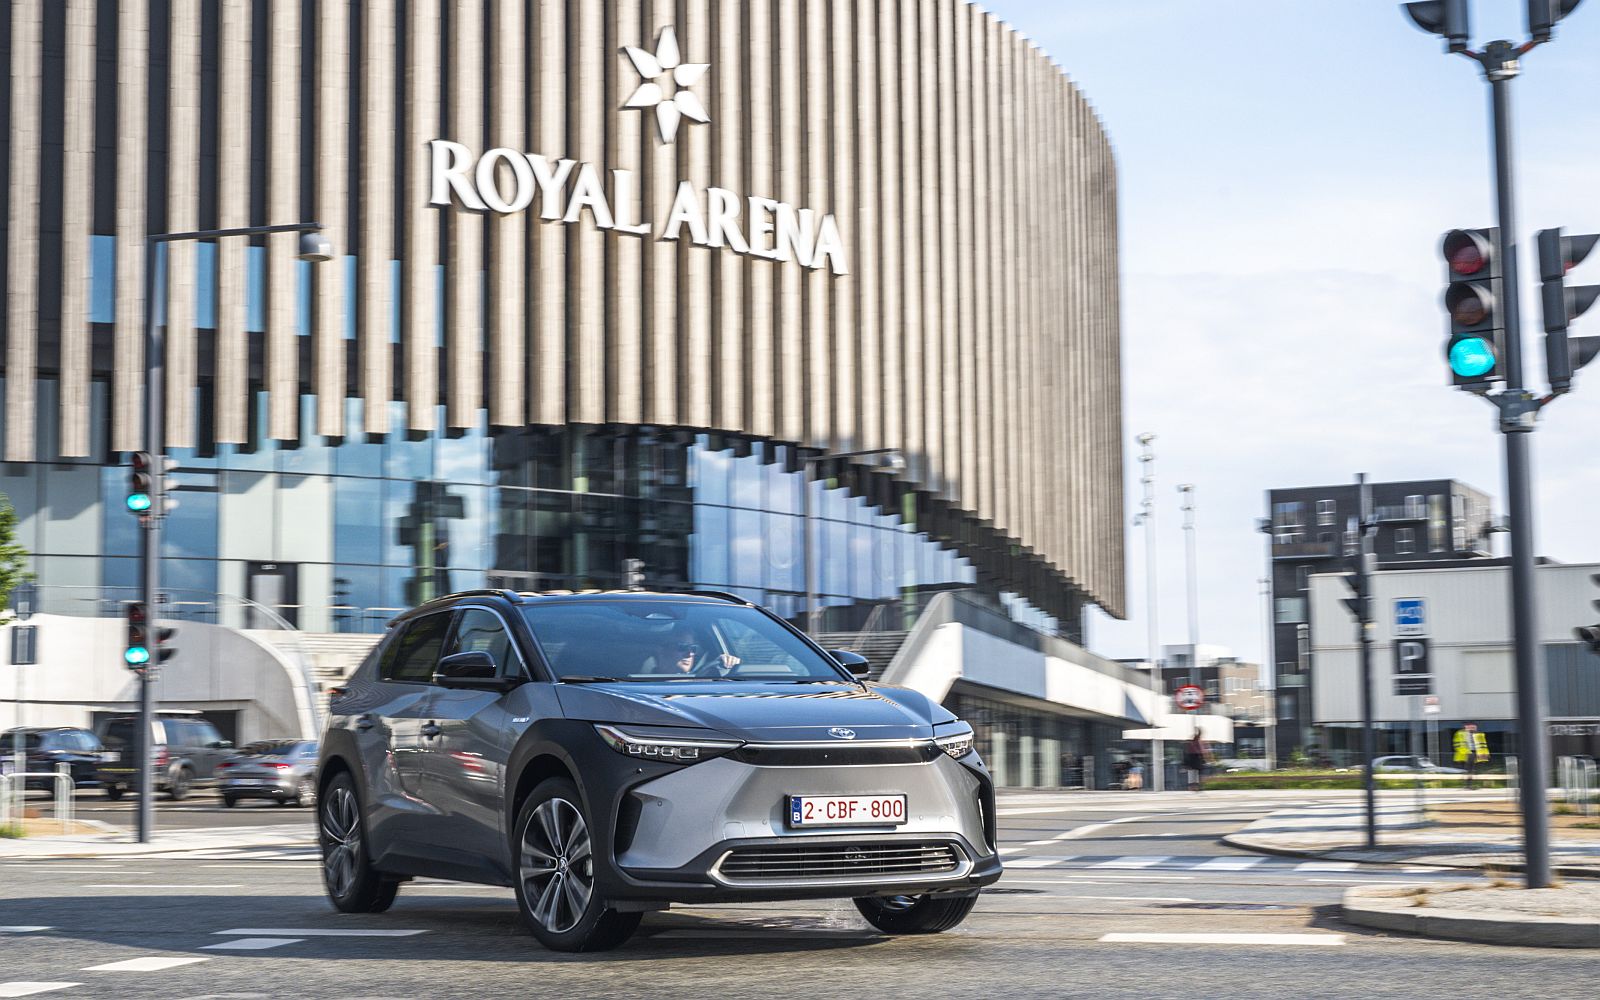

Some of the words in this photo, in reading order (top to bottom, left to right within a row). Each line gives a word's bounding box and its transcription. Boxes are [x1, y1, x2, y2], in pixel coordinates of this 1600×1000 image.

[429, 139, 651, 235] ROYAL
[662, 180, 849, 275] ARENA
[1399, 641, 1425, 671] P
[793, 812, 801, 821] B
